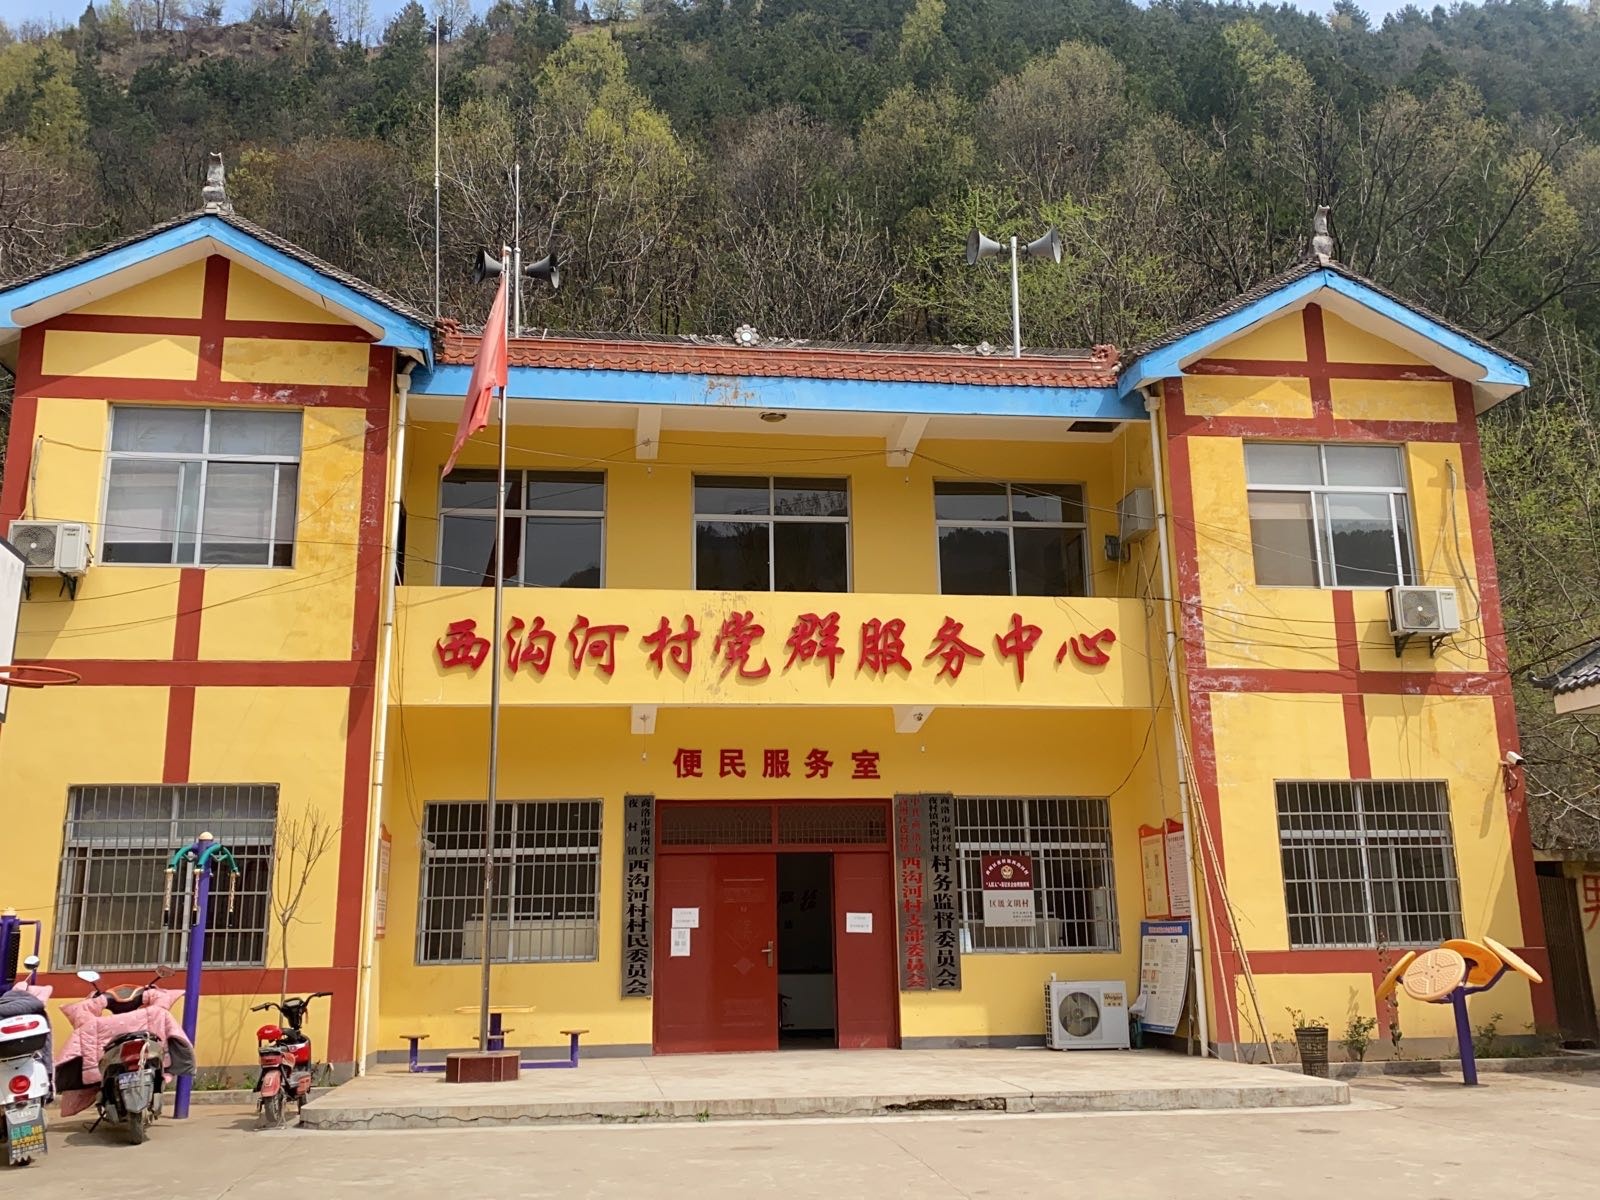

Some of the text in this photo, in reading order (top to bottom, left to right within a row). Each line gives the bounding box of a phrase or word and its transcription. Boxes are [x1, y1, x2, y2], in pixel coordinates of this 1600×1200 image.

[435, 611, 1114, 683] 西沟河村党群服务中心
[673, 747, 881, 779] 便民服务室
[627, 859, 649, 993] 西沟河村村民委员会
[903, 857, 927, 987] 西沟河村支部委员会
[932, 855, 956, 986] 村务监督委员会
